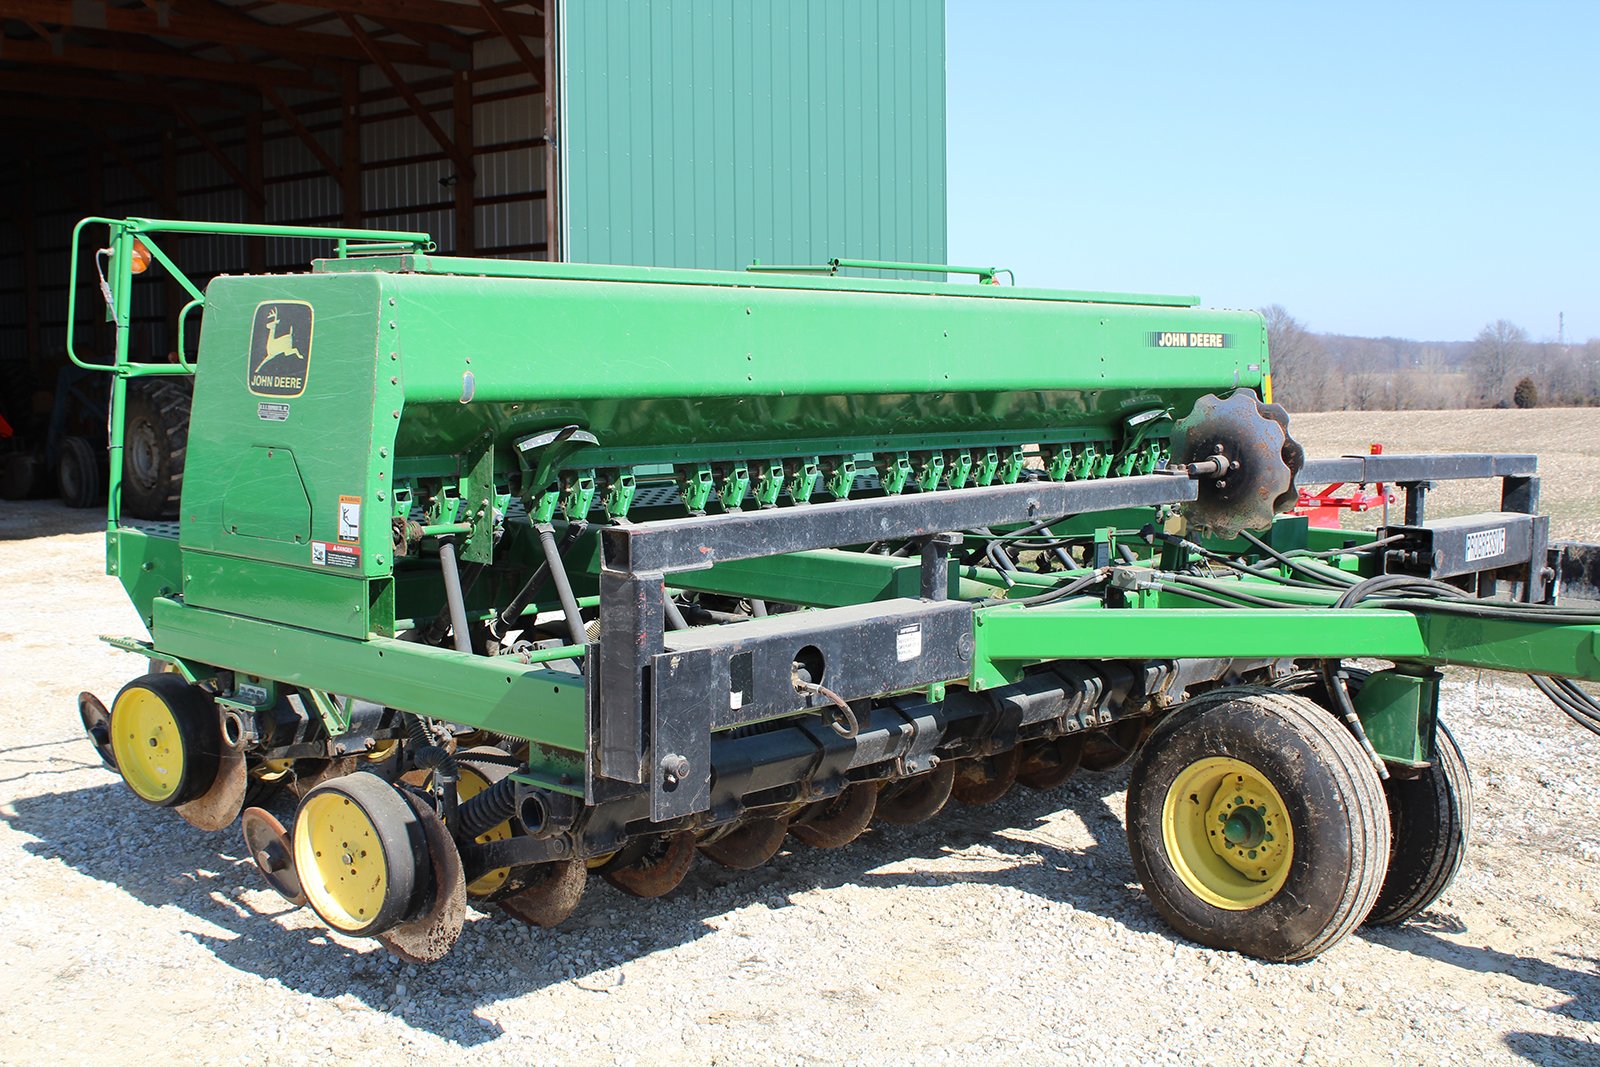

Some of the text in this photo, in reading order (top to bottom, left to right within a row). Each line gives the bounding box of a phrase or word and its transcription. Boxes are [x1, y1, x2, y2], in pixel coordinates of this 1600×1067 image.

[1159, 332, 1223, 348] JOHN DEERE
[251, 375, 302, 389] JOHN DEERE
